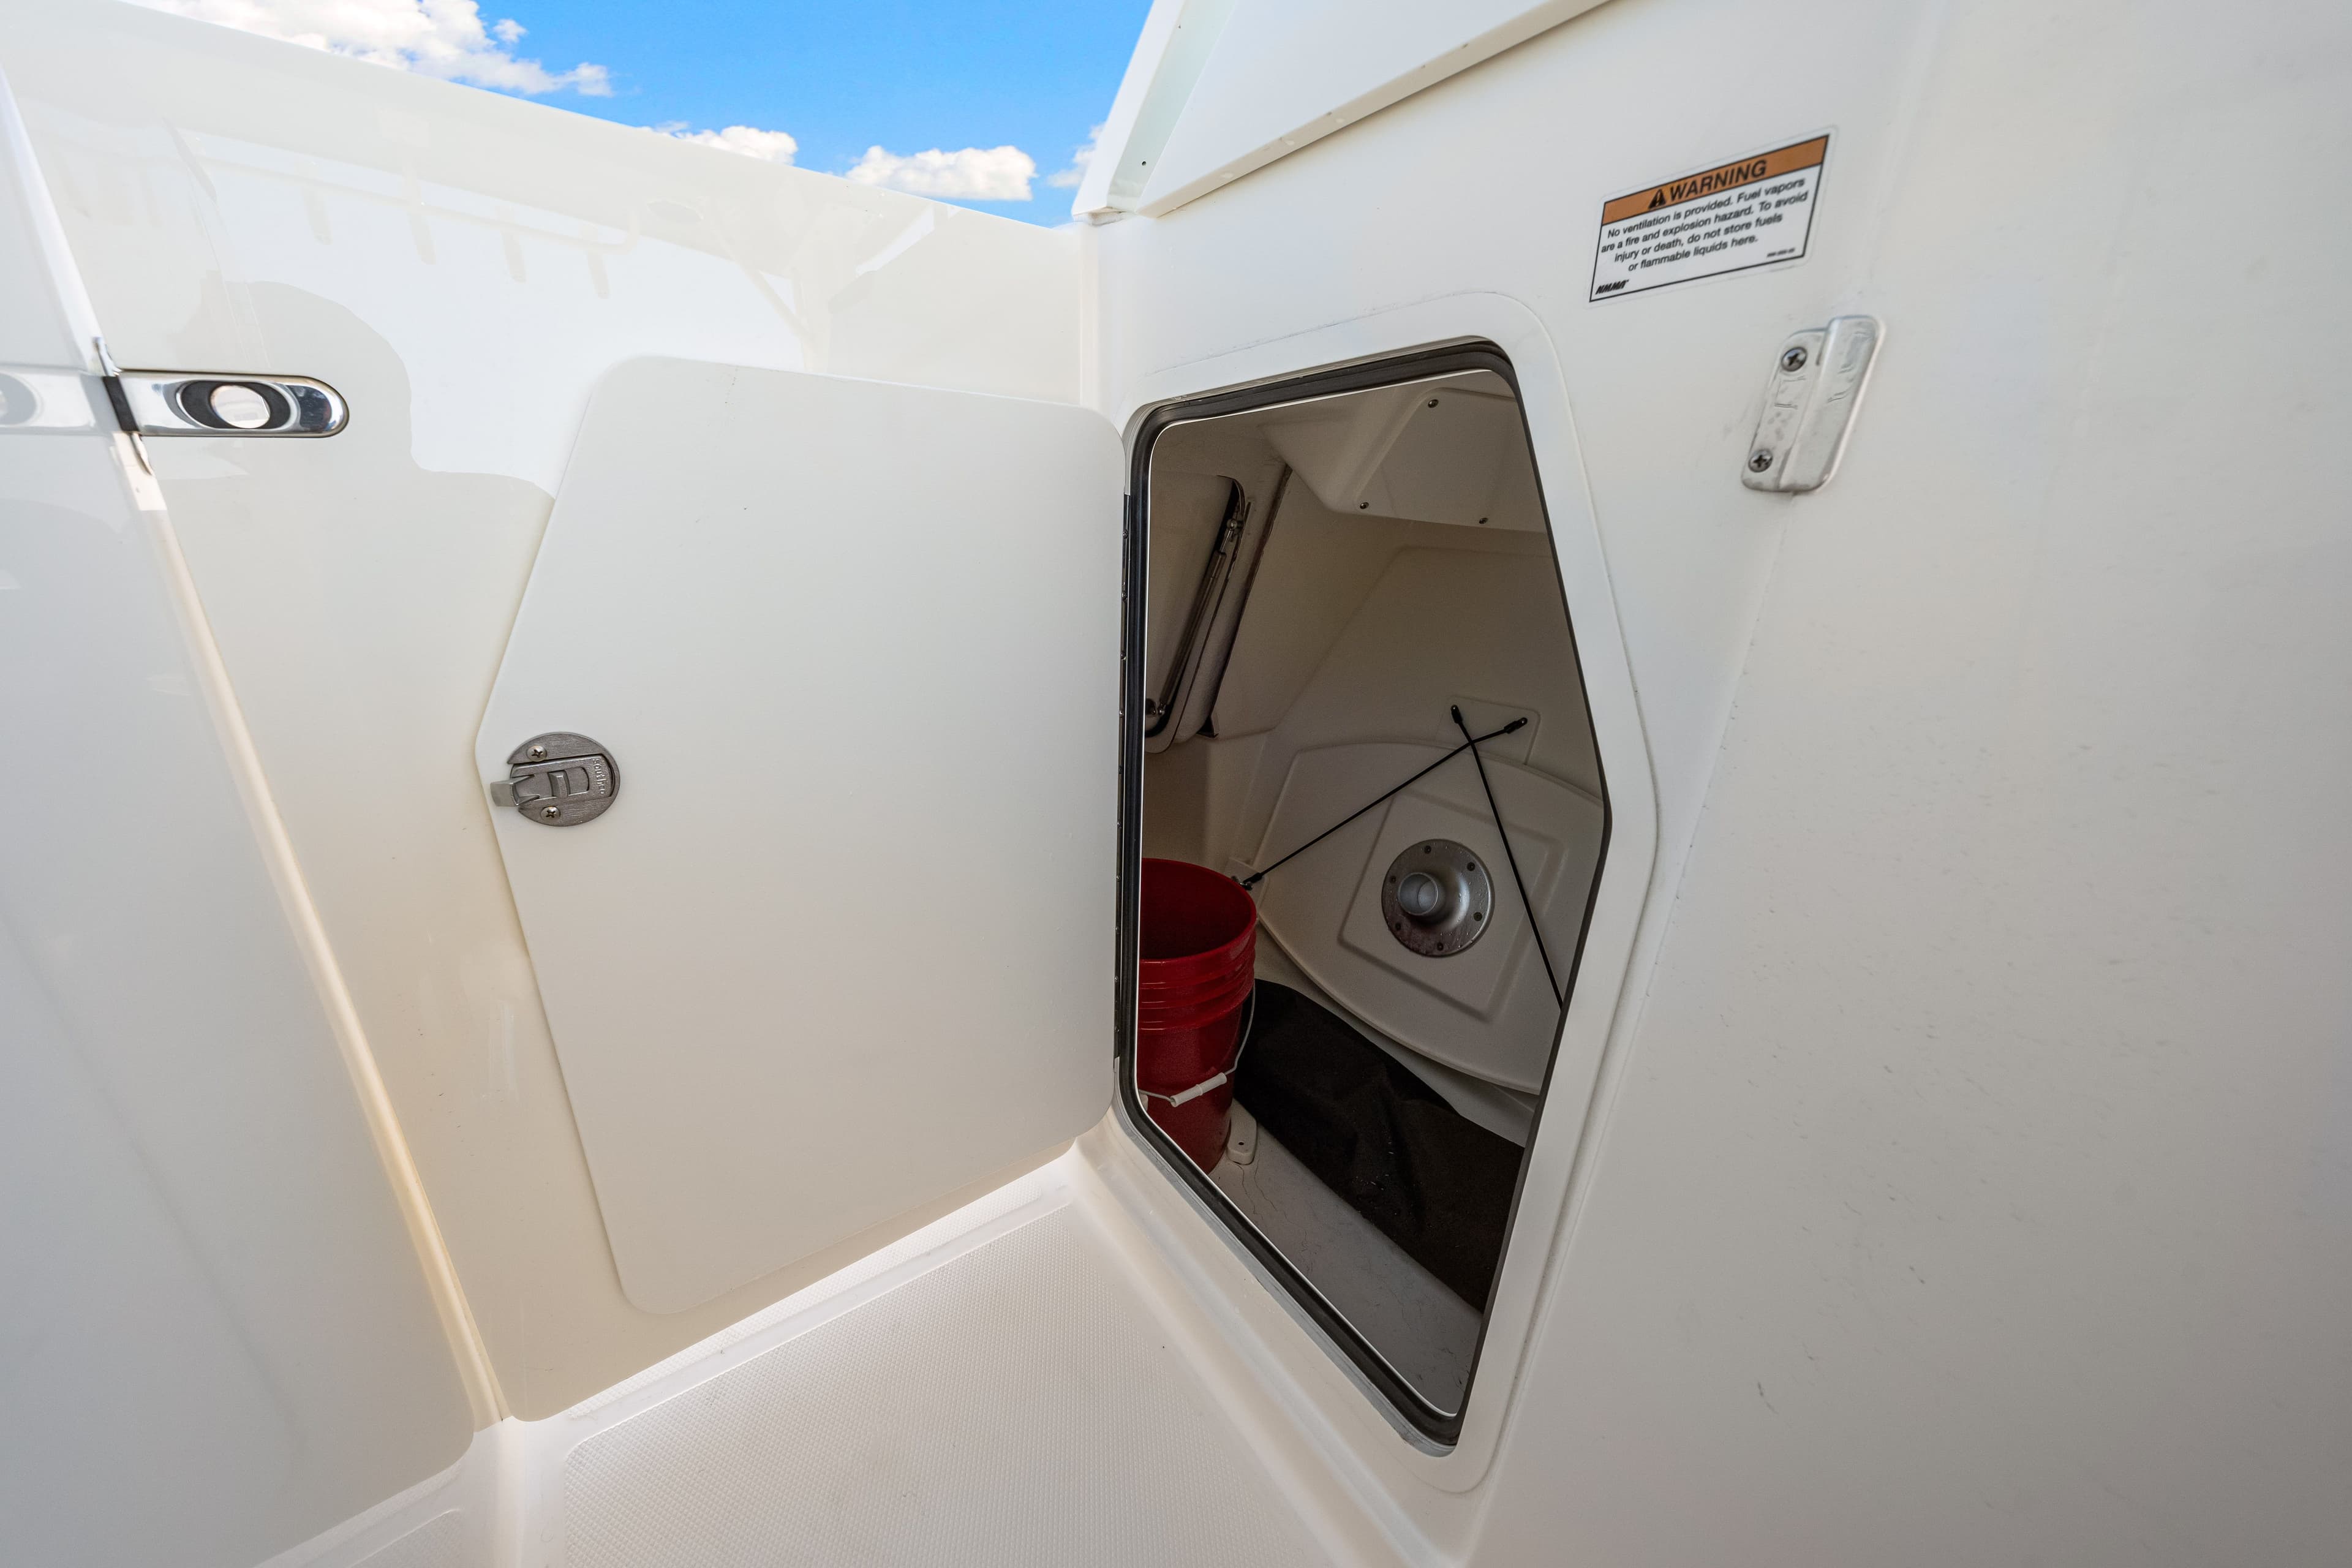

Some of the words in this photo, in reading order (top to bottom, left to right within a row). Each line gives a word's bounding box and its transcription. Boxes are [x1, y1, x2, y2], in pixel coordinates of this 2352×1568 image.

[1670, 159, 1766, 202] WARNING
[1601, 244, 1615, 253] are
[1626, 237, 1640, 246] fire
[1642, 230, 1660, 242] and
[1662, 217, 1711, 236] explosion
[1714, 205, 1754, 224] hazard.
[1759, 201, 1772, 213] To
[1774, 190, 1809, 208] avoid
[1608, 229, 1620, 238] No
[1623, 214, 1670, 234] ventilation
[1684, 196, 1733, 221] provided.
[1737, 187, 1762, 203] Fuel
[1765, 178, 1806, 195] vapors
[1615, 249, 1639, 262] injury
[1642, 246, 1651, 255] or
[1654, 238, 1684, 252] death,
[1687, 234, 1701, 244] do
[1703, 228, 1721, 240] not
[1724, 221, 1752, 235] store
[1755, 213, 1783, 227] fuels
[1628, 263, 1638, 271] or
[1640, 249, 1691, 269] flammable
[1693, 239, 1728, 257] liquids
[1731, 235, 1758, 247] here.
